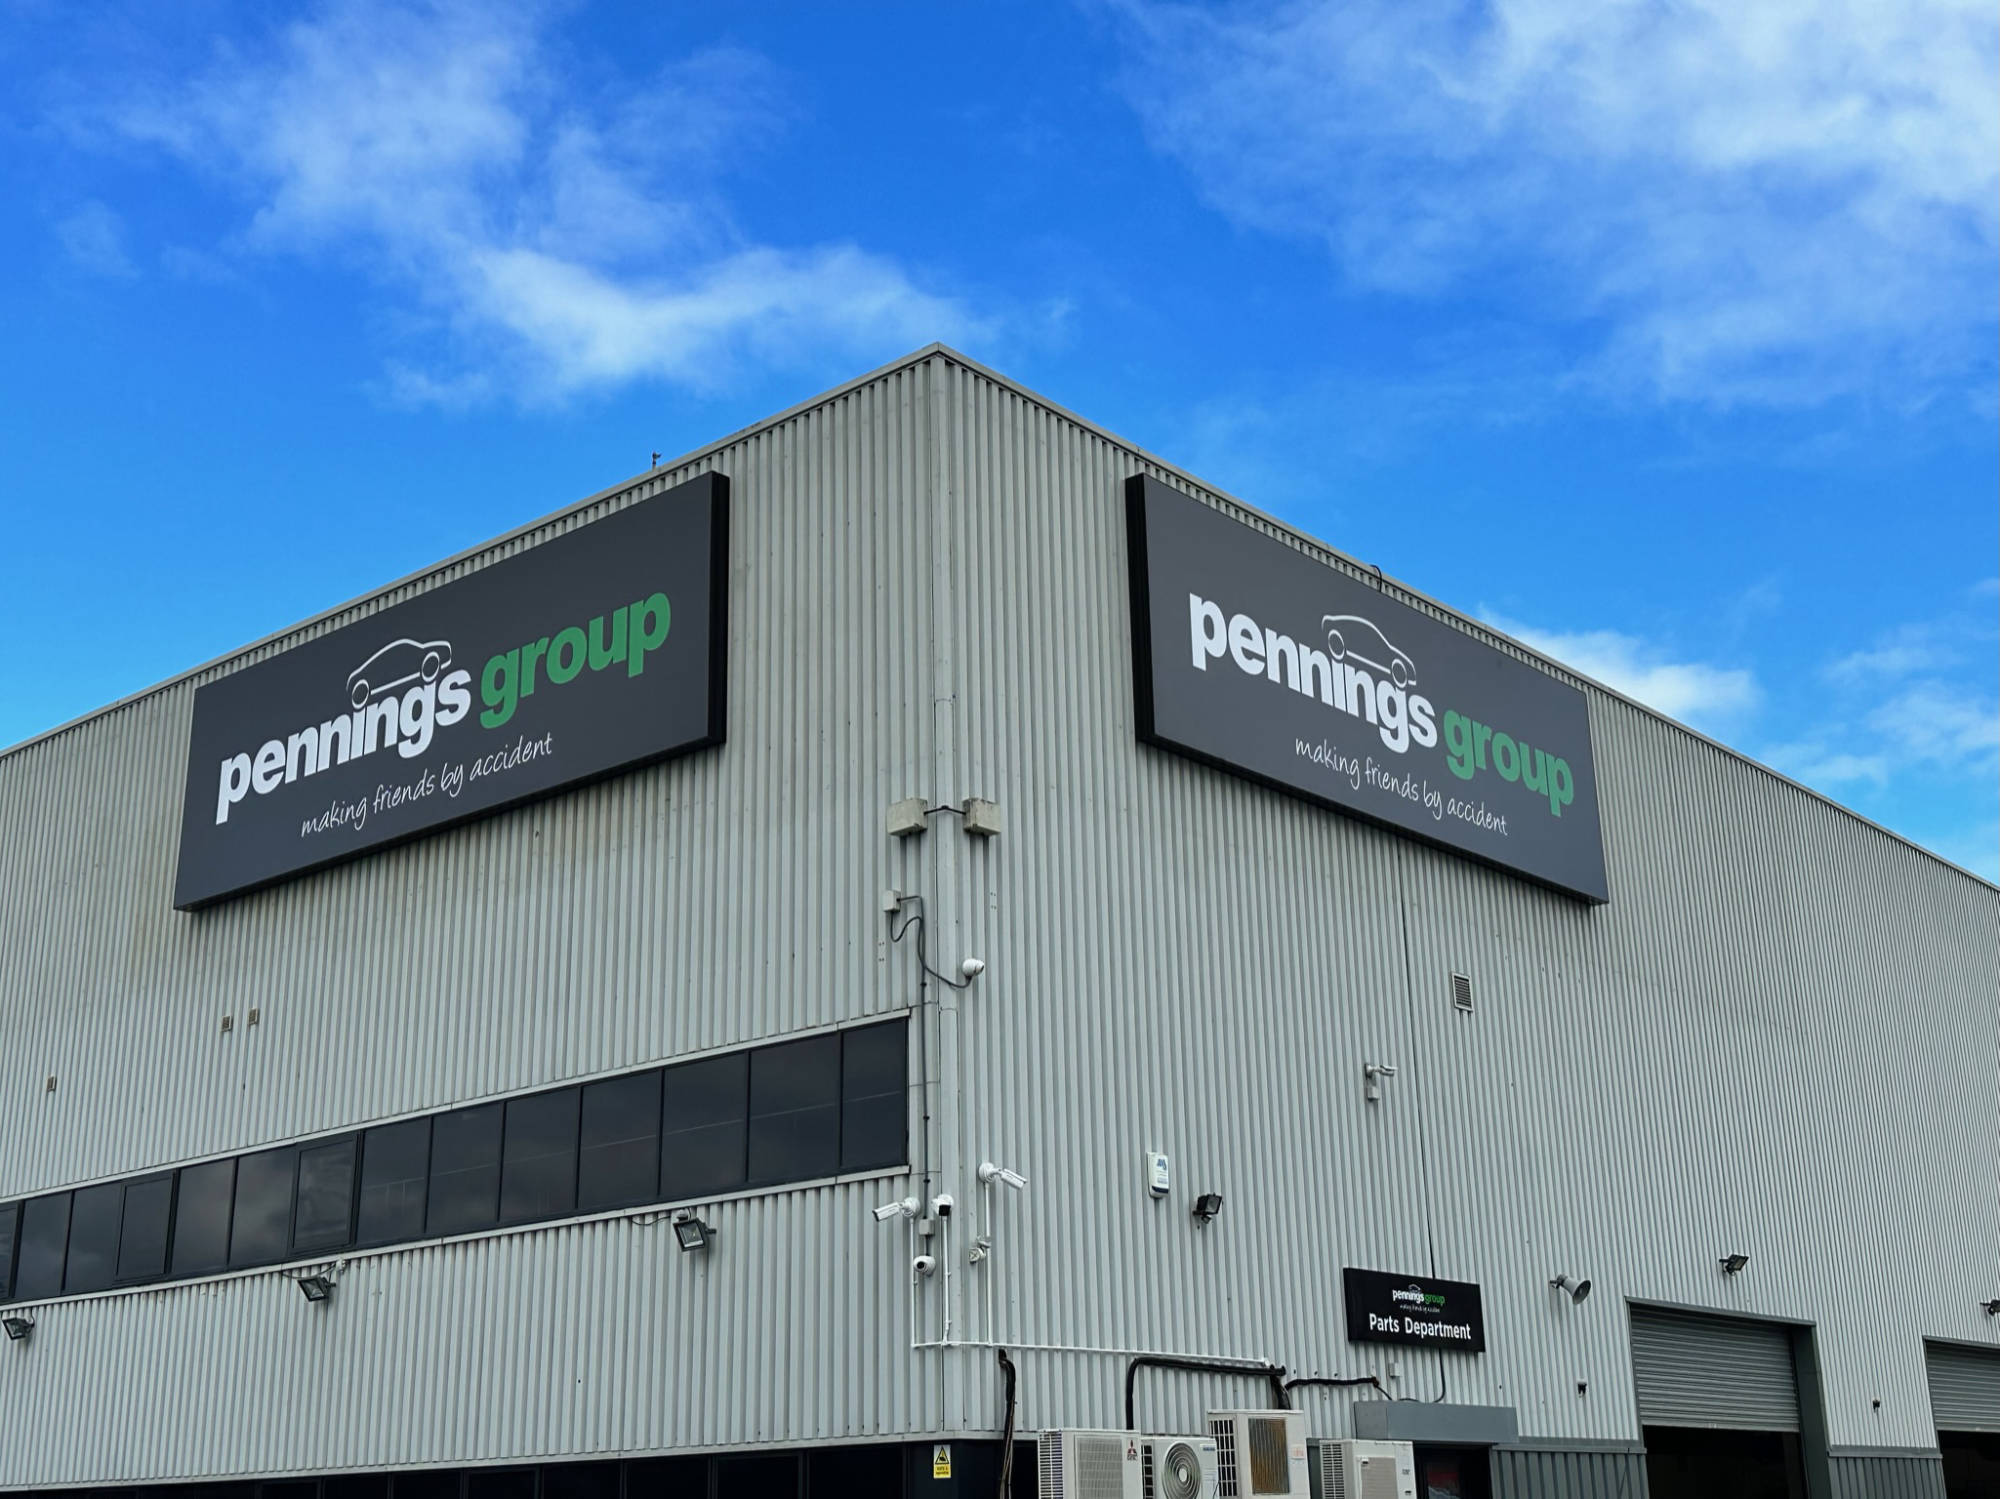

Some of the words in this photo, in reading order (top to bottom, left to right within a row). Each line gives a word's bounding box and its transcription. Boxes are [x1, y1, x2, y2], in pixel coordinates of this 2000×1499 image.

[216, 669, 472, 825] pennings
[480, 592, 671, 728] group
[1189, 592, 1438, 754] pennings
[1443, 708, 1574, 817] group
[301, 797, 367, 837] making
[373, 768, 436, 814] friends
[440, 762, 464, 798] by
[469, 732, 553, 781] accident
[1295, 738, 1361, 790] making
[1365, 756, 1419, 801] friends
[1423, 780, 1442, 820] by
[1447, 798, 1508, 836] accident
[1369, 1313, 1400, 1333] Parts
[1404, 1316, 1472, 1339] Department
[1392, 1289, 1424, 1304] pennings
[1424, 1294, 1446, 1307] group
